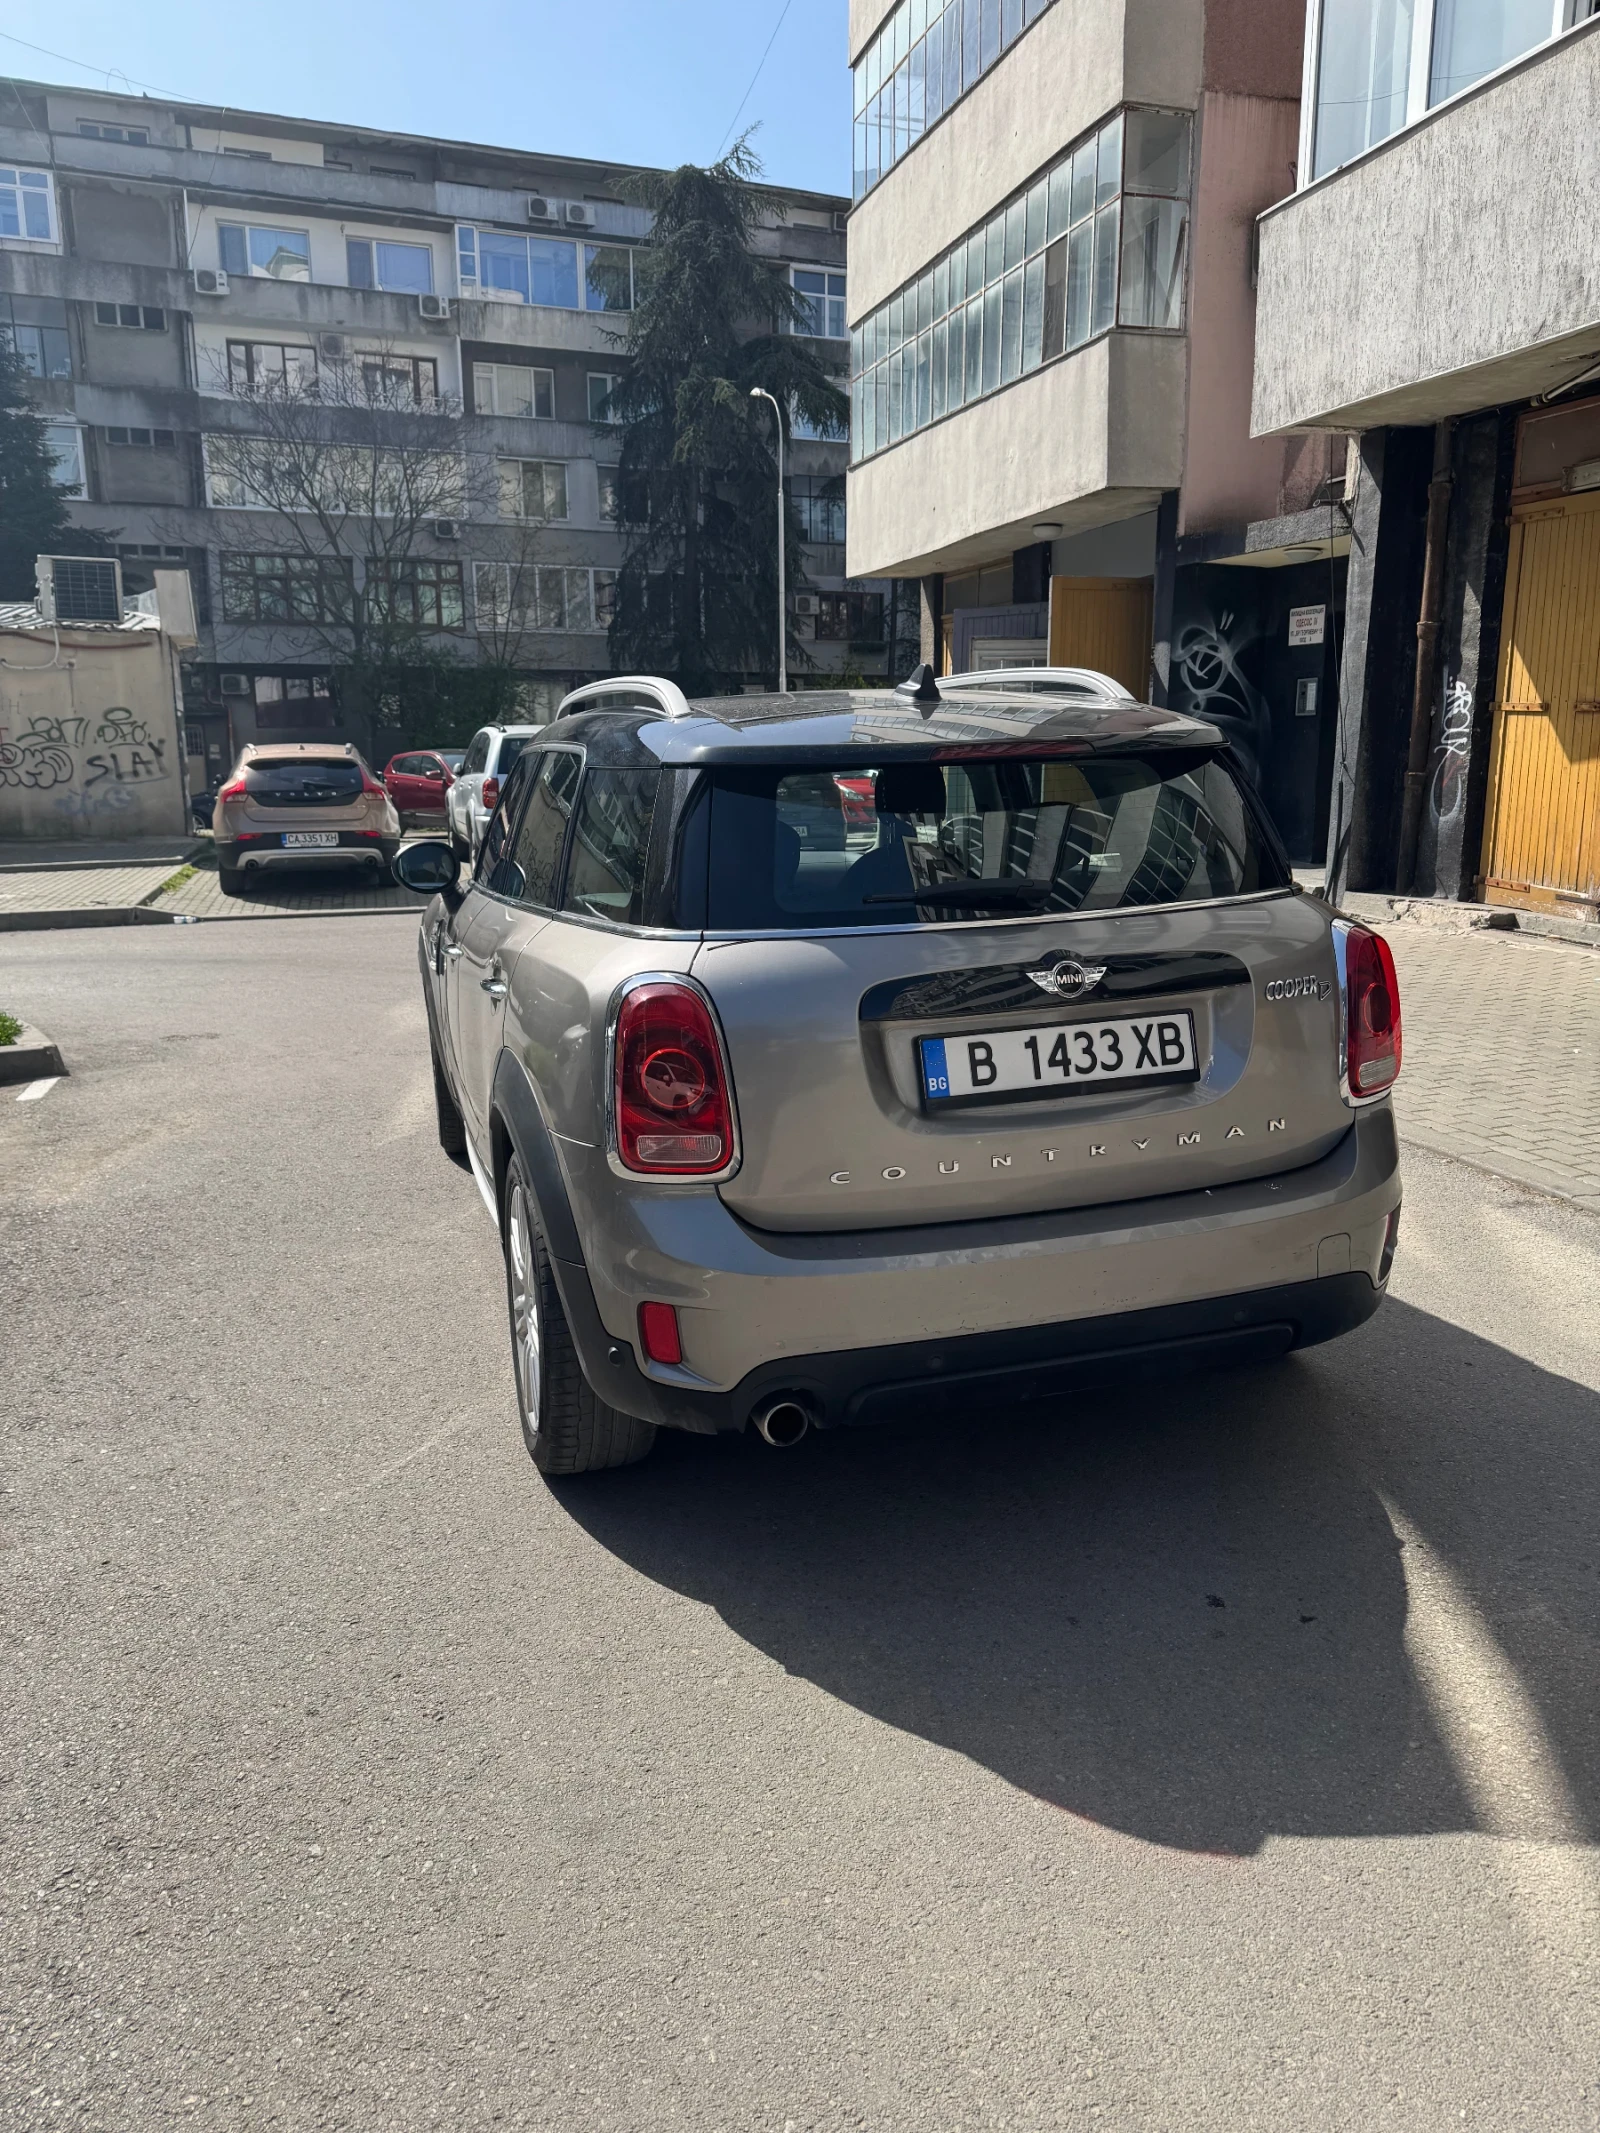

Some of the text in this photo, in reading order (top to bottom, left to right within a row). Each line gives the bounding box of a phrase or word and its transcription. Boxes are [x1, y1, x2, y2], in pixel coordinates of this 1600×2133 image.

[287, 832, 337, 844] CA 3351 XH
[1056, 972, 1083, 986] MINI
[1265, 975, 1318, 1001] COOPER
[967, 1021, 1185, 1087] B 1433 XB
[928, 1076, 948, 1092] BG
[829, 1117, 1287, 1185] COUNTRYMAN
